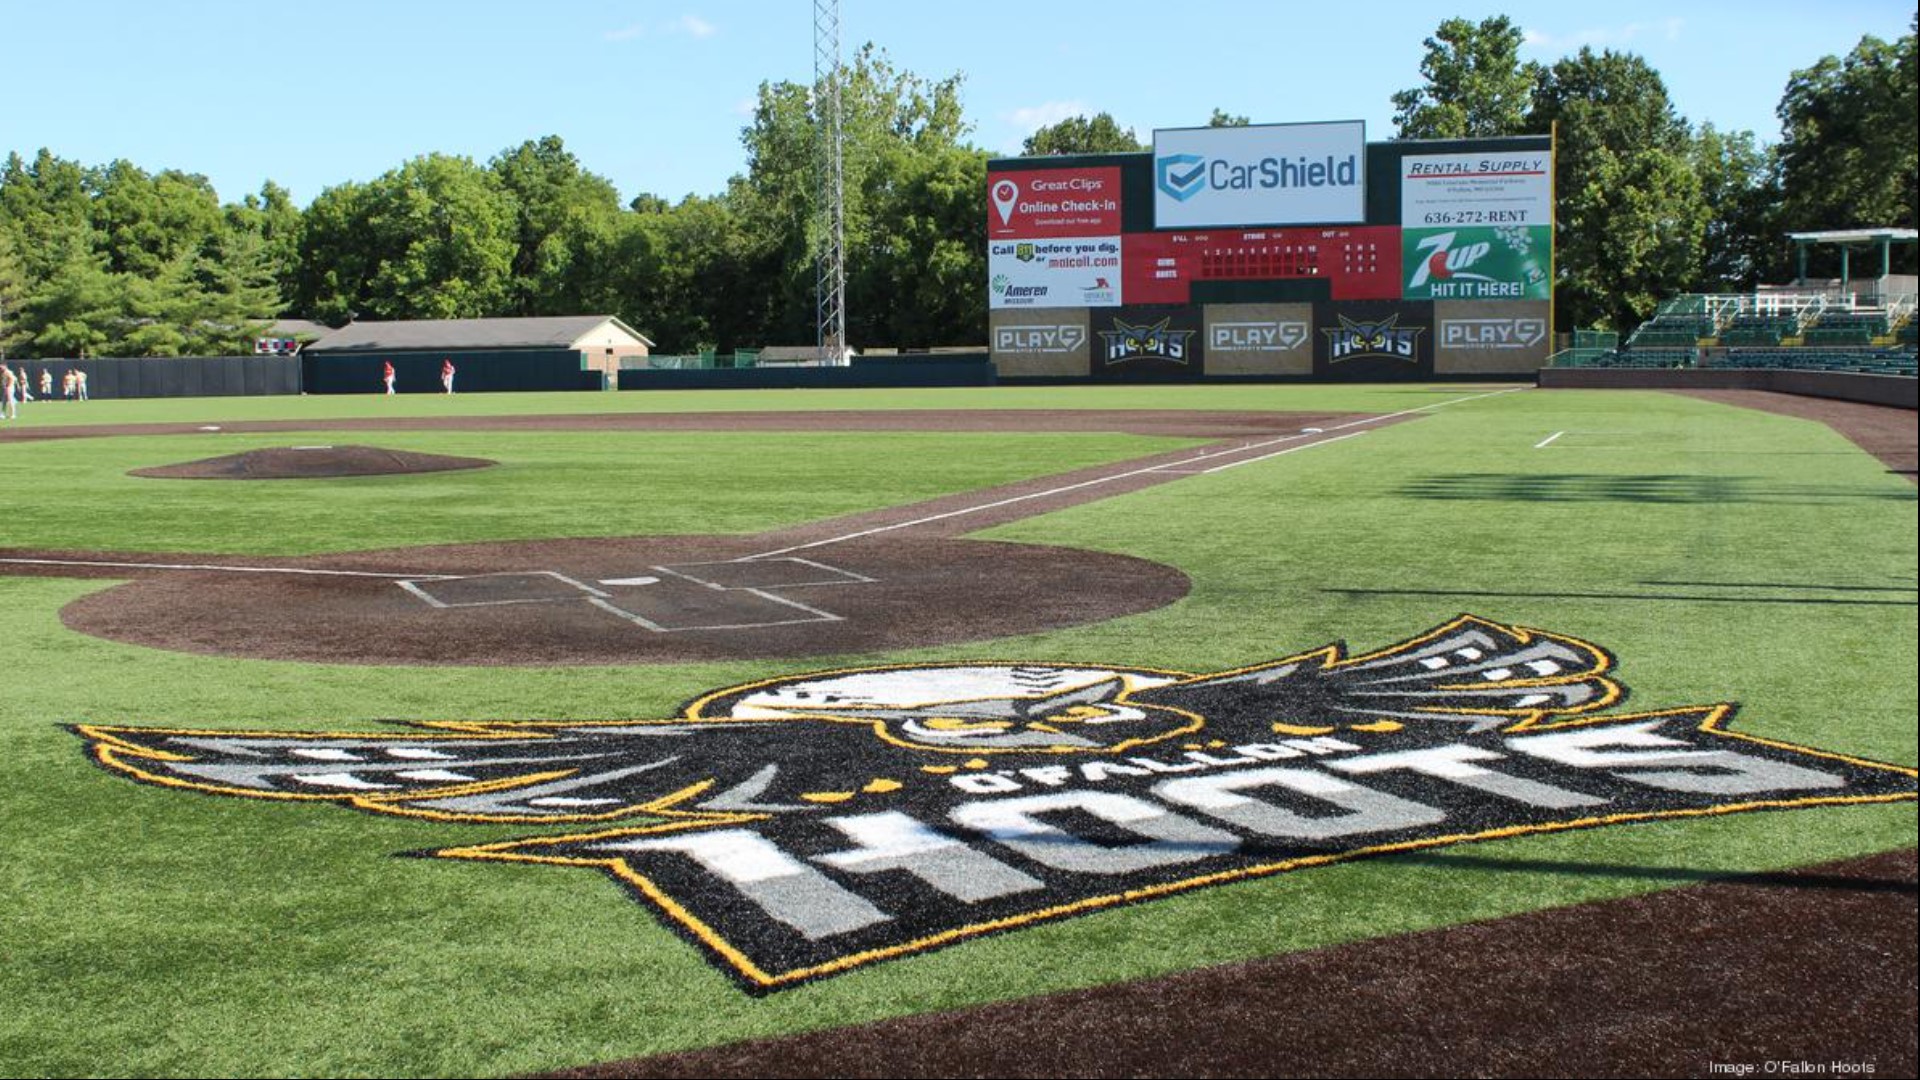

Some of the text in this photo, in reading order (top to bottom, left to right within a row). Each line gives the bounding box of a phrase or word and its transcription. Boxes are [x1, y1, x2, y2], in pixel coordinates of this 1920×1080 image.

[1210, 155, 1356, 190] CarShield
[1411, 160, 1542, 174] RENTAL SUPPLY
[1031, 178, 1103, 192] Great Clips
[1019, 199, 1116, 213] Online Check-in
[1424, 210, 1528, 224] 636-272-RENT
[992, 246, 1014, 255] Call
[1035, 244, 1072, 254] before
[1075, 244, 1095, 255] you
[1098, 243, 1119, 254] dig.
[1409, 230, 1490, 288] 7UP
[1005, 285, 1048, 297] Ameren
[1431, 281, 1525, 297] HIT IT HERE!
[1000, 331, 1056, 347] PLAY
[1216, 329, 1276, 345] PLAY
[1448, 325, 1513, 342] PLAY
[949, 736, 1362, 793] O'FALLON
[586, 721, 1847, 940] HOOTS
